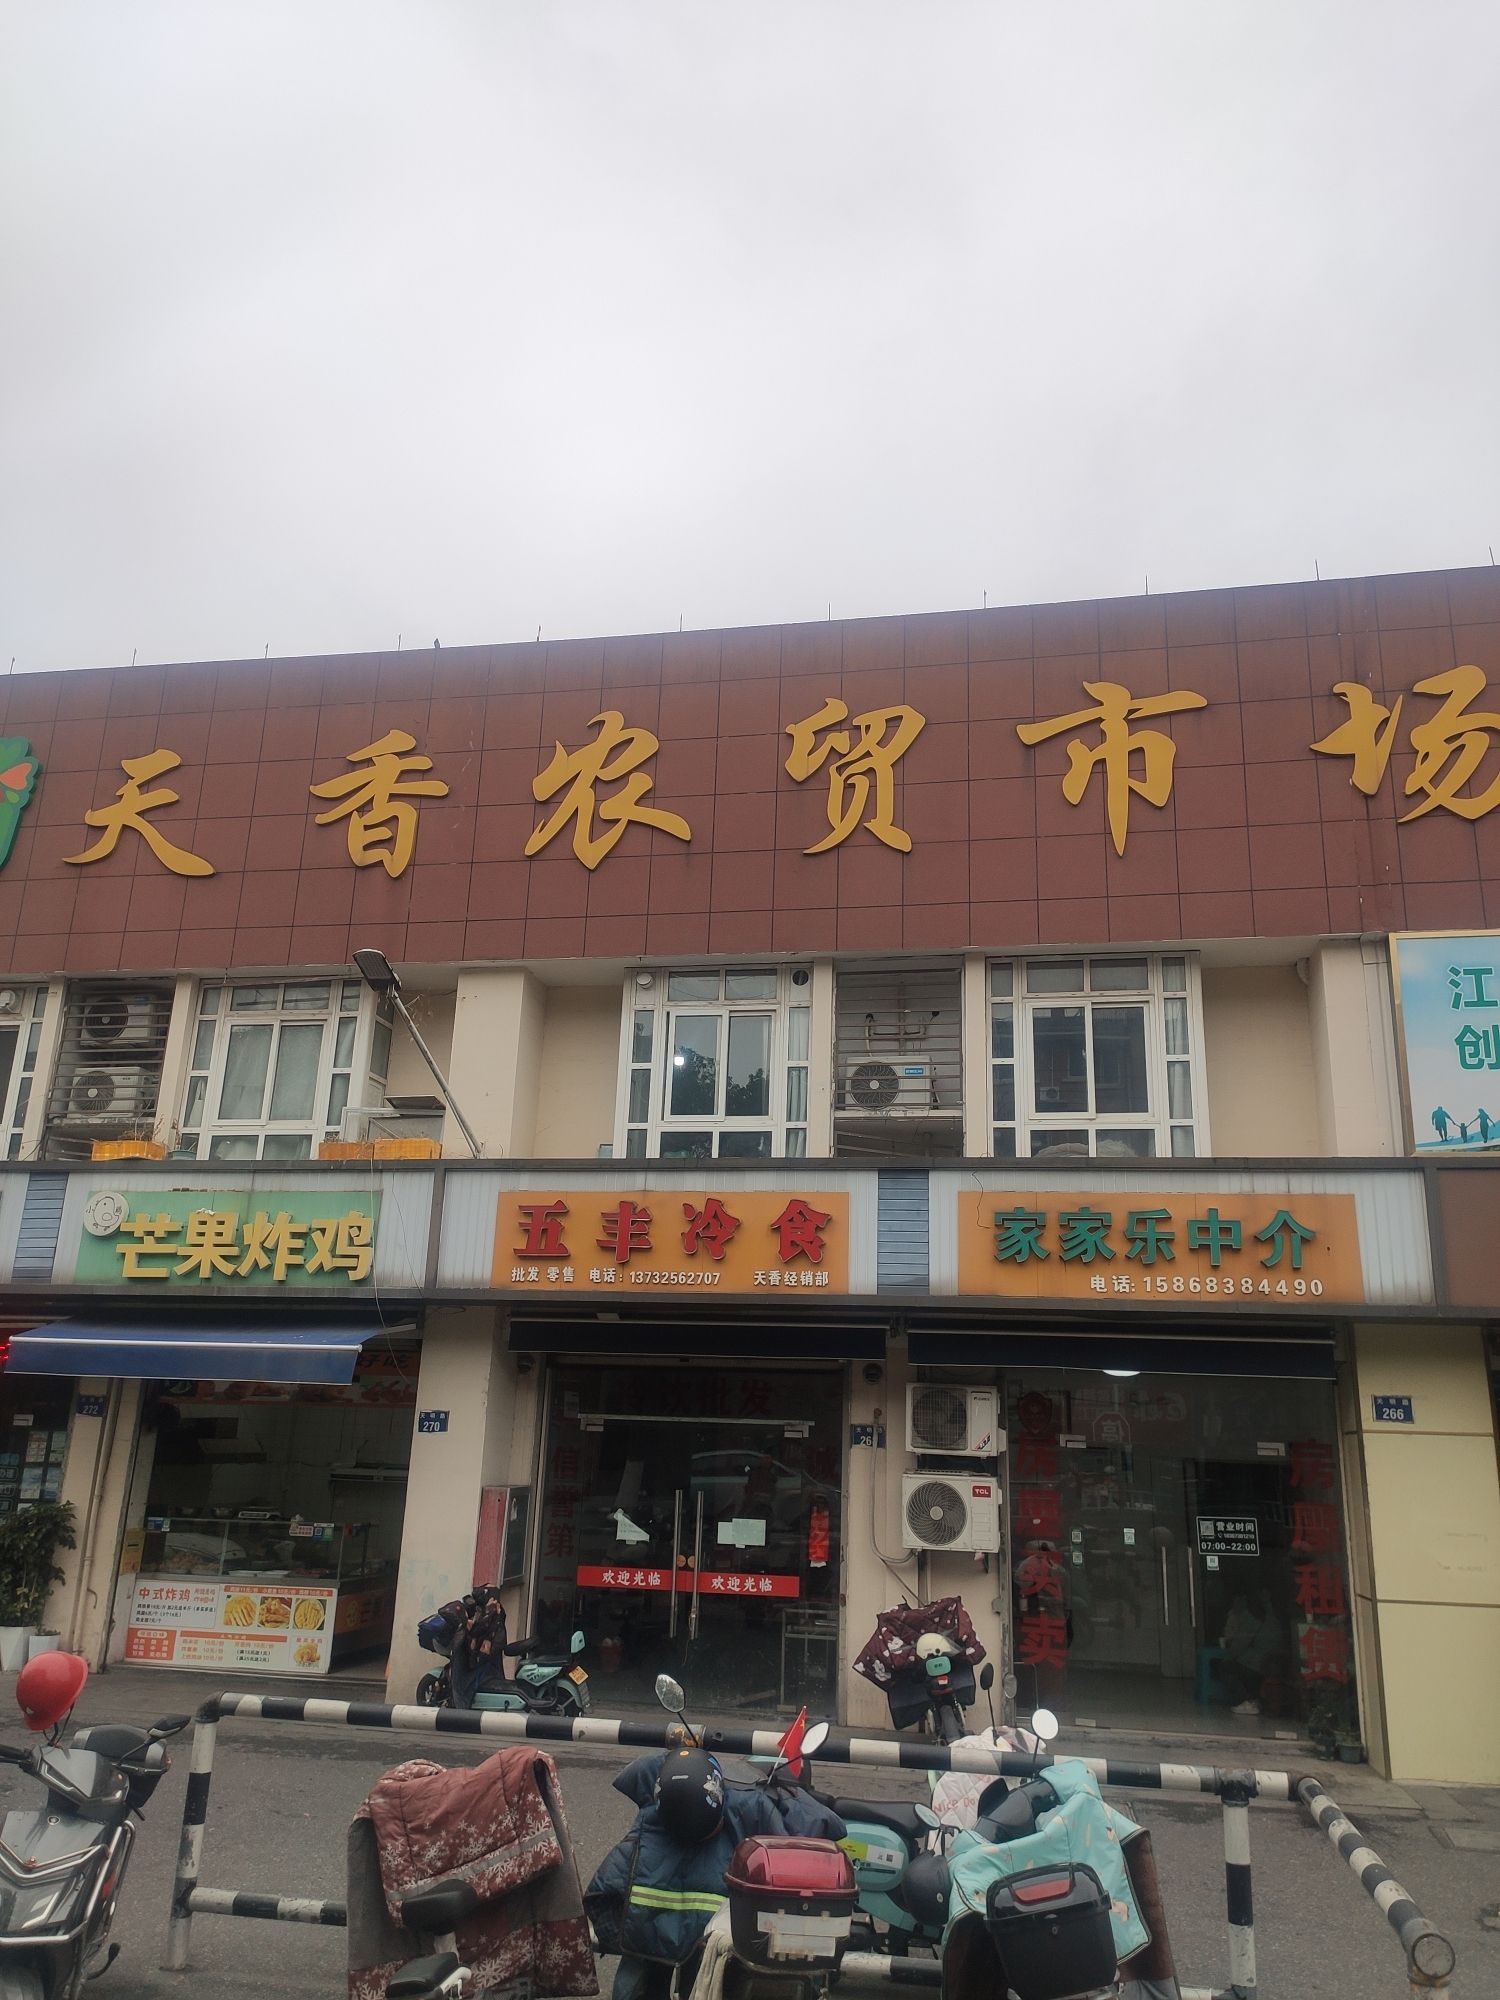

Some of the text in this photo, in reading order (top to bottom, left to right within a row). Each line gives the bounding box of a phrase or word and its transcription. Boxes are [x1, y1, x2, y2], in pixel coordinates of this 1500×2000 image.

[62, 664, 1500, 878] 天香农贸市场
[1448, 966, 1499, 1010] 江
[1454, 1024, 1500, 1070] 创
[512, 1198, 832, 1264] 五丰冷食
[993, 1207, 1316, 1269] 家家乐中介
[116, 1210, 375, 1281] 芒果炸鸡
[511, 1267, 540, 1282] 批发
[547, 1266, 575, 1282] 零售
[753, 1270, 829, 1287] 天香经销部
[1382, 1407, 1404, 1420] 266
[423, 1422, 440, 1432] 270
[860, 1435, 874, 1446] 26
[1216, 1521, 1254, 1532] 营业时间
[1201, 1542, 1256, 1551] 07:00-22:00
[602, 1569, 661, 1587] 欢迎光临
[711, 1575, 773, 1592] 欢迎光临
[139, 1587, 191, 1601] 中式炸鸡
